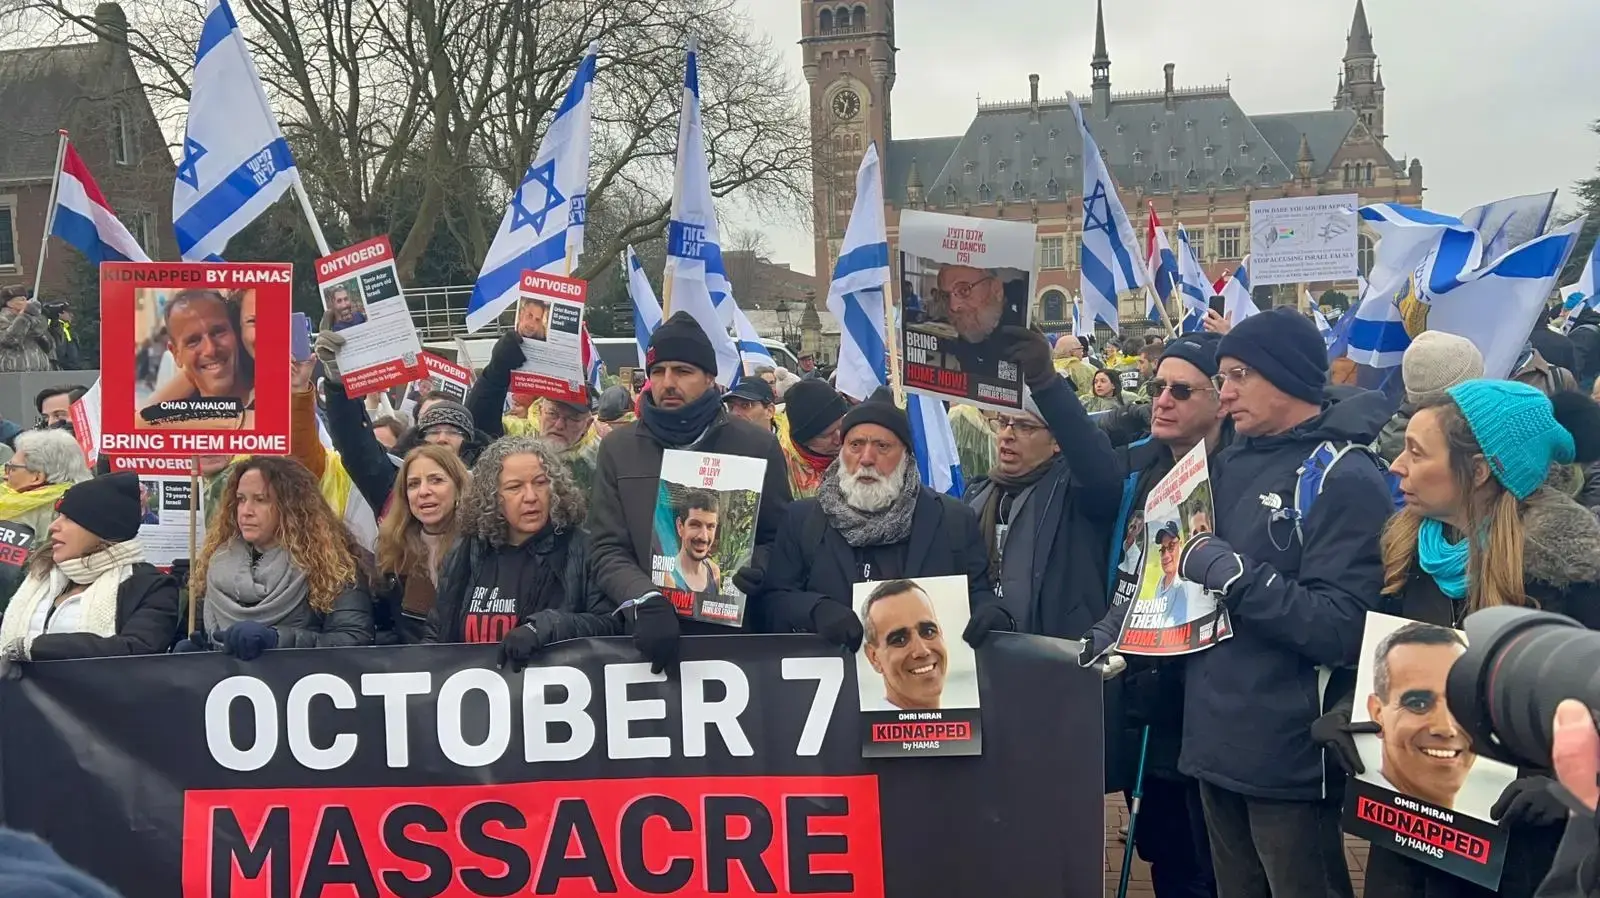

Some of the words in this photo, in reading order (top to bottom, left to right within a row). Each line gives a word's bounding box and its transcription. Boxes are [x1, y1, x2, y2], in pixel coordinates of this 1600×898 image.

[942, 240, 958, 251] ALEX
[959, 241, 986, 254] DANCYG
[320, 243, 385, 275] ONTVOERD
[956, 253, 970, 264] (75)
[104, 269, 200, 282] KIDNAPPED
[206, 270, 227, 282] BY
[232, 270, 290, 283] HAMAS
[525, 276, 582, 296] ONTVOERD
[906, 332, 938, 350] BRING
[906, 347, 927, 364] HIM
[907, 365, 936, 384] HOME
[937, 371, 969, 390] NOW!
[160, 402, 187, 410] OHAD
[190, 402, 237, 410] YAHALOMI
[102, 434, 164, 450] BRING
[170, 435, 223, 450] THEM
[229, 435, 286, 450] HOME
[18, 533, 30, 546] 7
[652, 554, 675, 572] BRING
[492, 598, 517, 613] HOME
[671, 591, 695, 609] NOW!
[1133, 596, 1168, 614] BRING
[1129, 613, 1166, 629] THEM
[1123, 629, 1158, 646] HOME
[1159, 623, 1191, 645] NOW!
[205, 660, 754, 773] OCTOBER
[781, 657, 844, 757] 7
[898, 713, 917, 721] OMRI
[918, 712, 942, 720] MIRAN
[876, 724, 967, 740] KIDNAPPED
[902, 742, 912, 750] by
[912, 741, 940, 749] HAMAS
[1394, 796, 1420, 812] OMRI
[1420, 805, 1454, 823] MIRAN
[1361, 801, 1485, 858] KIDNAPPED
[206, 794, 855, 898] MASSACRE
[1394, 833, 1407, 847] by
[1408, 838, 1444, 859] HAMAS
